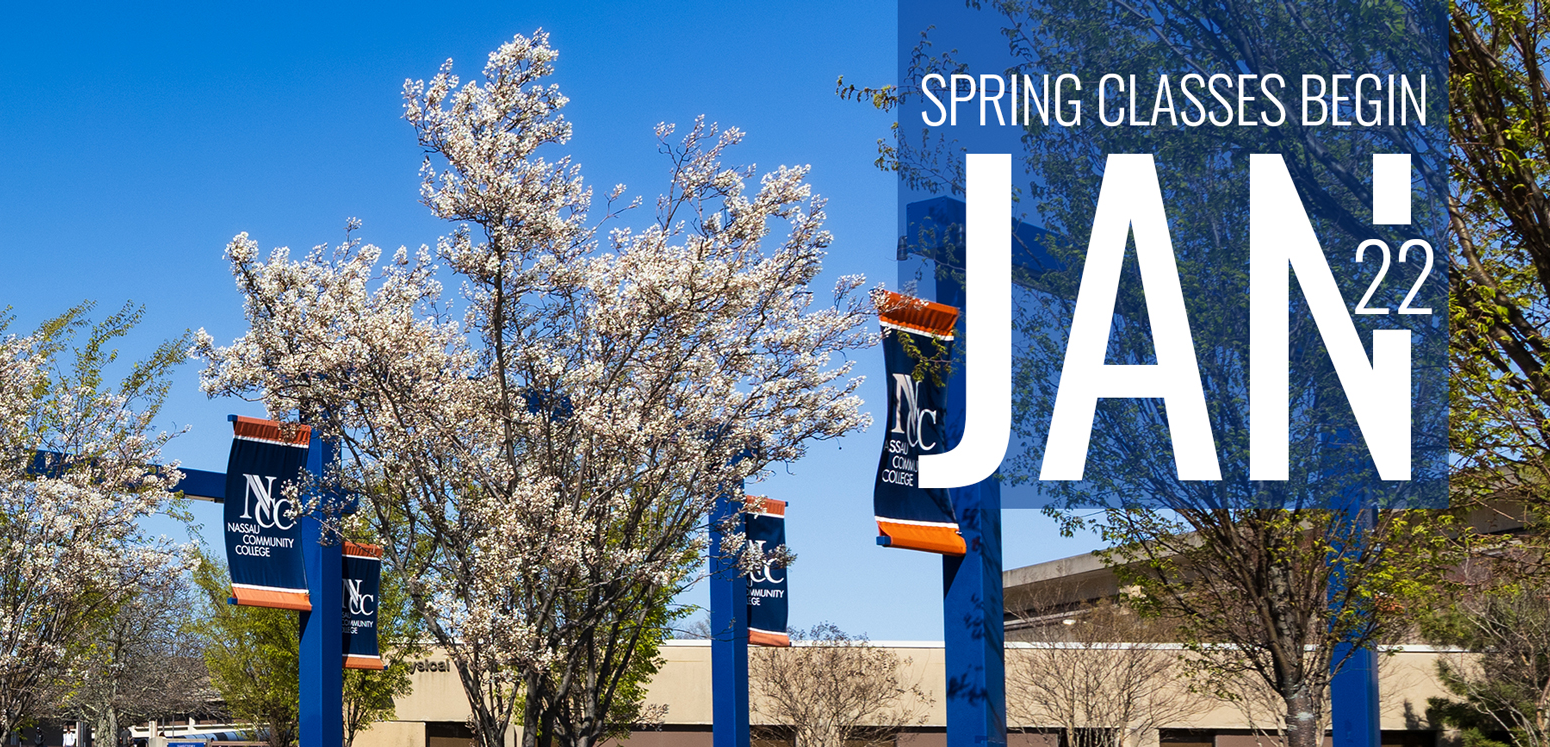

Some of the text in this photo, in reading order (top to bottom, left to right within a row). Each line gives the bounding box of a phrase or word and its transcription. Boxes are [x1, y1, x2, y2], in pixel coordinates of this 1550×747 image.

[891, 373, 937, 450] NCC
[884, 440, 908, 455] ASSAU
[892, 455, 918, 472] COMMU
[881, 469, 914, 486] COLLEGE
[239, 473, 297, 530] NCC
[227, 522, 260, 534] NASSAU
[242, 534, 294, 548] COMMUNITY
[235, 545, 271, 557] COLLEGE
[410, 659, 450, 675] ysical
